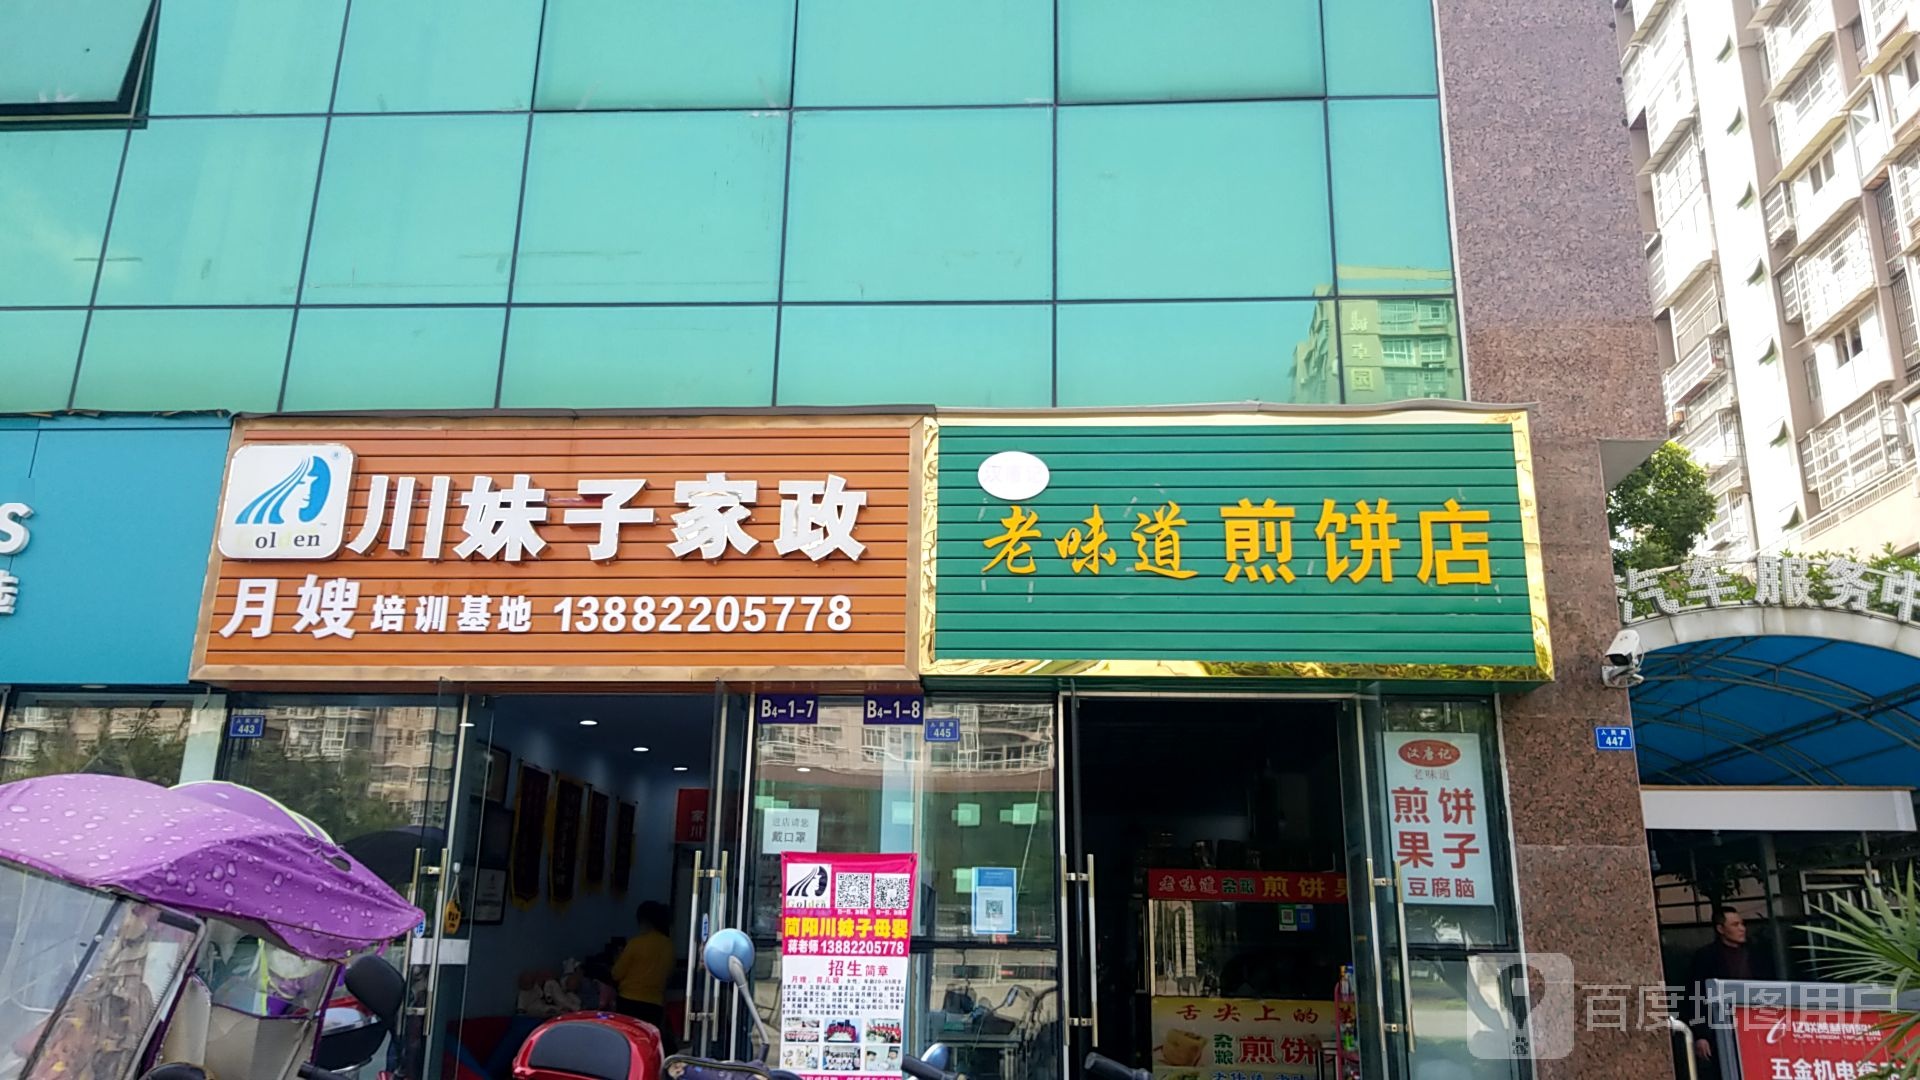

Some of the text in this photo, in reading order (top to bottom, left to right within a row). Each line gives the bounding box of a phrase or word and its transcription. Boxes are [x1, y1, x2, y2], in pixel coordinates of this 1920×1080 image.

[345, 473, 868, 562] 川妹子家政
[982, 498, 1492, 585] 老味道煎饼店
[1614, 555, 1920, 623] 汽车服务中
[218, 574, 852, 639] 月嫂培训基地 13882205778
[238, 724, 255, 734] 443
[933, 728, 951, 738] 445
[1605, 736, 1624, 747] 447
[1414, 768, 1451, 781] 老味道
[1391, 786, 1477, 825] 煎饼
[772, 831, 806, 843] 戴口罩
[1397, 831, 1480, 869] 果子
[1407, 877, 1475, 898] 豆腐脑
[785, 917, 908, 938] 简阳川妹子母婴
[820, 940, 905, 955] 13882205778
[828, 959, 889, 977] 招生简章
